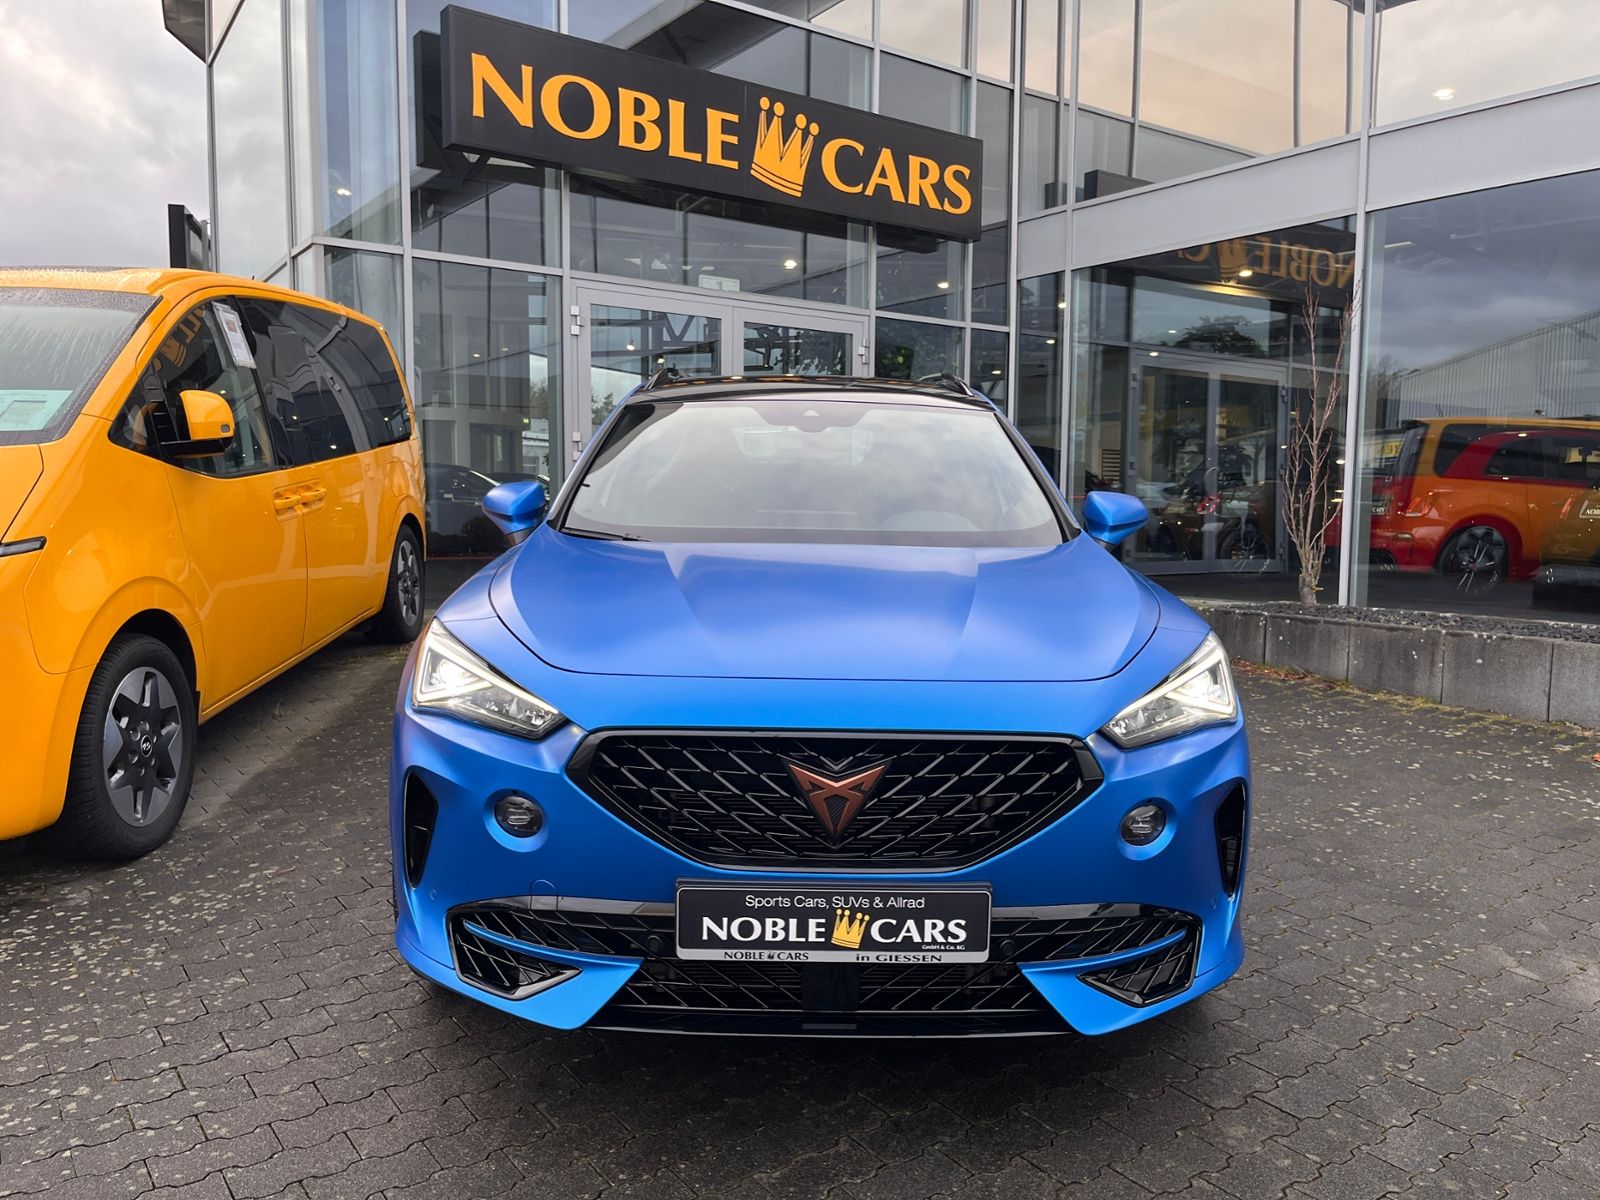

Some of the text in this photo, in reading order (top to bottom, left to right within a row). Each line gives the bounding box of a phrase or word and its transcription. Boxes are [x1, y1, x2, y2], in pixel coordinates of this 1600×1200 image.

[470, 52, 973, 216] NOBLE CARS
[745, 895, 925, 909] Sports Cars, SUVs & Allrad
[702, 916, 967, 943] NOBLE CARS
[723, 951, 809, 960] NOBLE CARS
[855, 953, 943, 962] in GIESSEN
